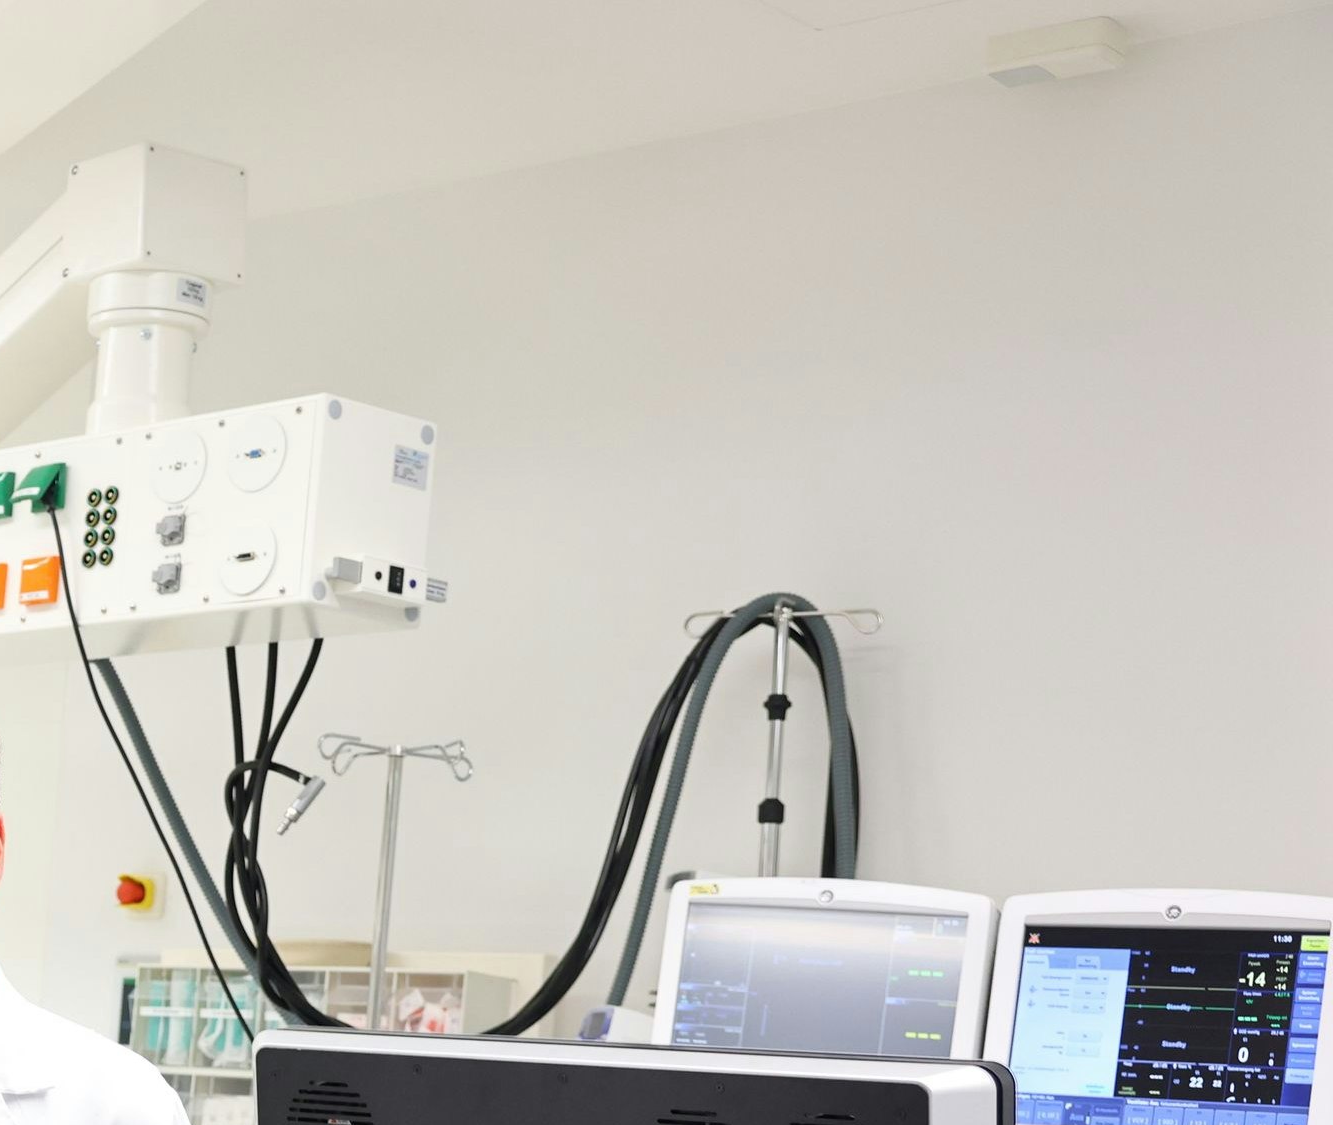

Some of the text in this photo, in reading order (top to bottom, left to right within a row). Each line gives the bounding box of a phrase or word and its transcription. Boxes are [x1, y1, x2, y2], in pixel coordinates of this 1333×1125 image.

[1170, 965, 1196, 975] Standby
[1238, 971, 1266, 987] -14
[1161, 1039, 1187, 1050] Standby
[1238, 1046, 1249, 1063] 0
